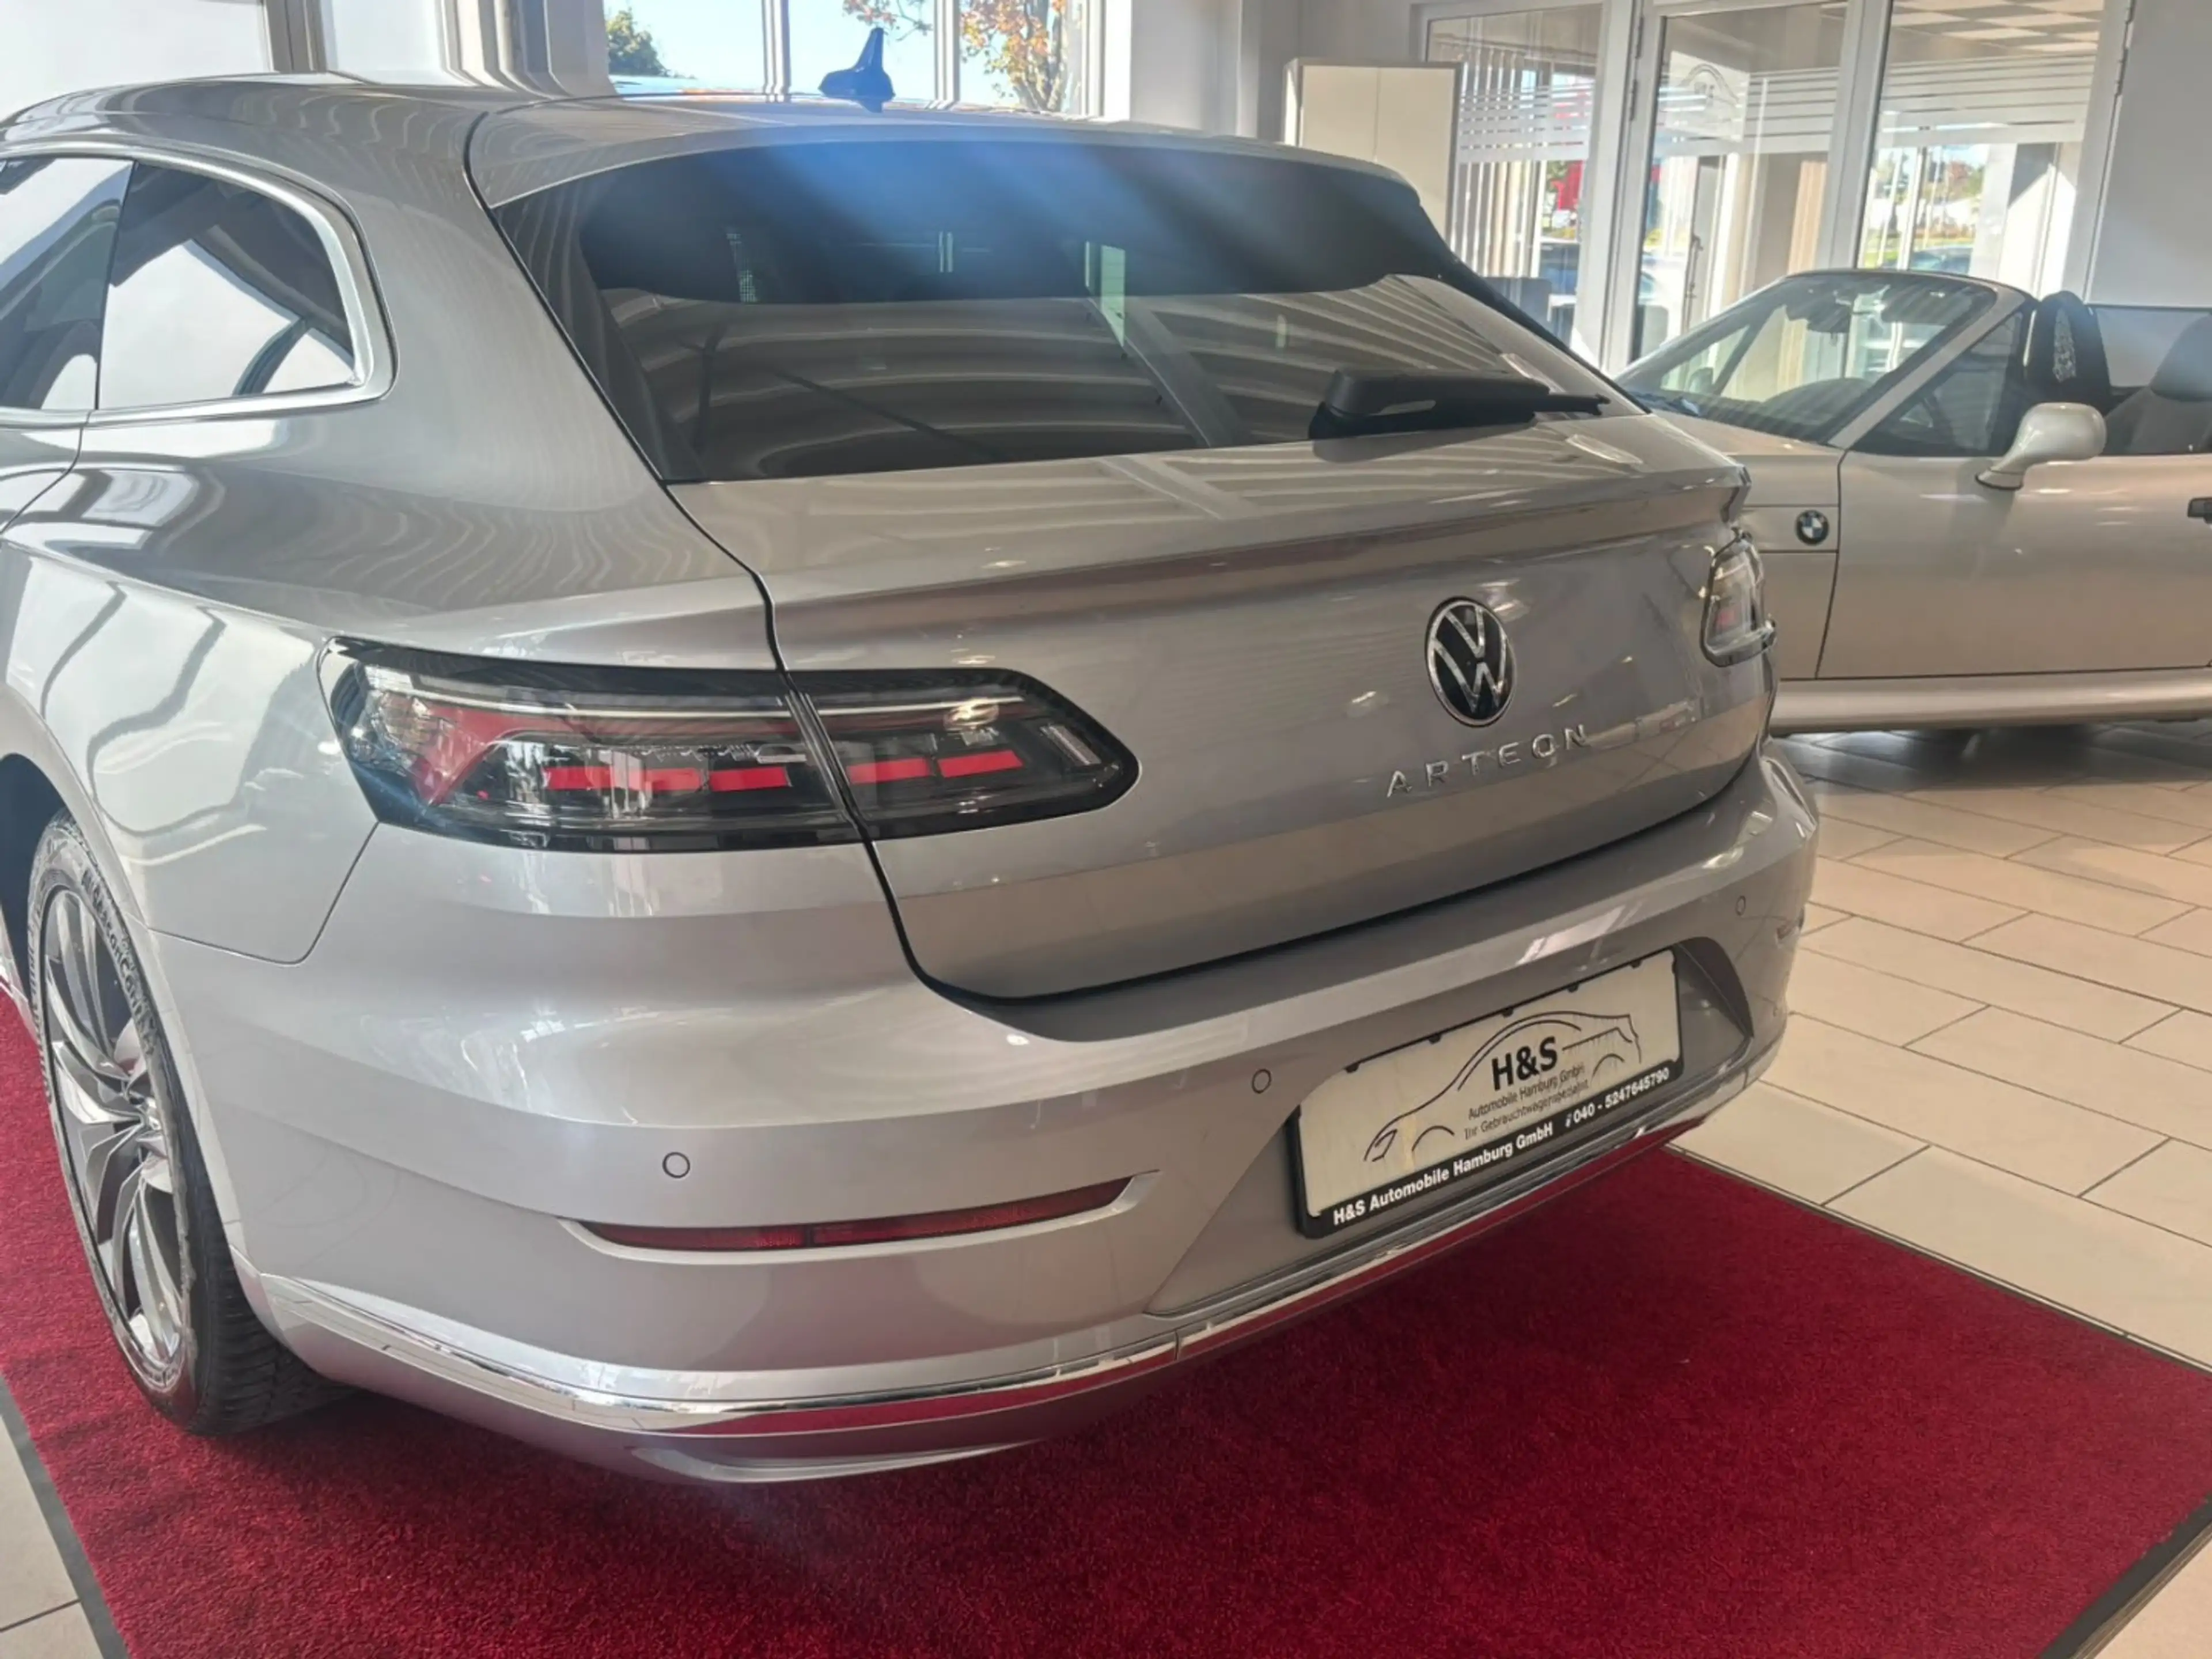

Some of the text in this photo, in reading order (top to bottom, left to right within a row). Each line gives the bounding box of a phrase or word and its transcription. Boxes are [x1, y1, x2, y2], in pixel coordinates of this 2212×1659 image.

[1386, 724, 1587, 798] ARTEON
[1491, 1036, 1558, 1091] H&S
[1468, 1091, 1518, 1120] Automobile
[1518, 1074, 1559, 1100] Hamburg
[1333, 1200, 1366, 1226] H&S
[1368, 1167, 1450, 1210] Automobile
[1452, 1140, 1514, 1176] Hamburg
[1516, 1121, 1554, 1149] GmbH
[1573, 1101, 1596, 1124] 040
